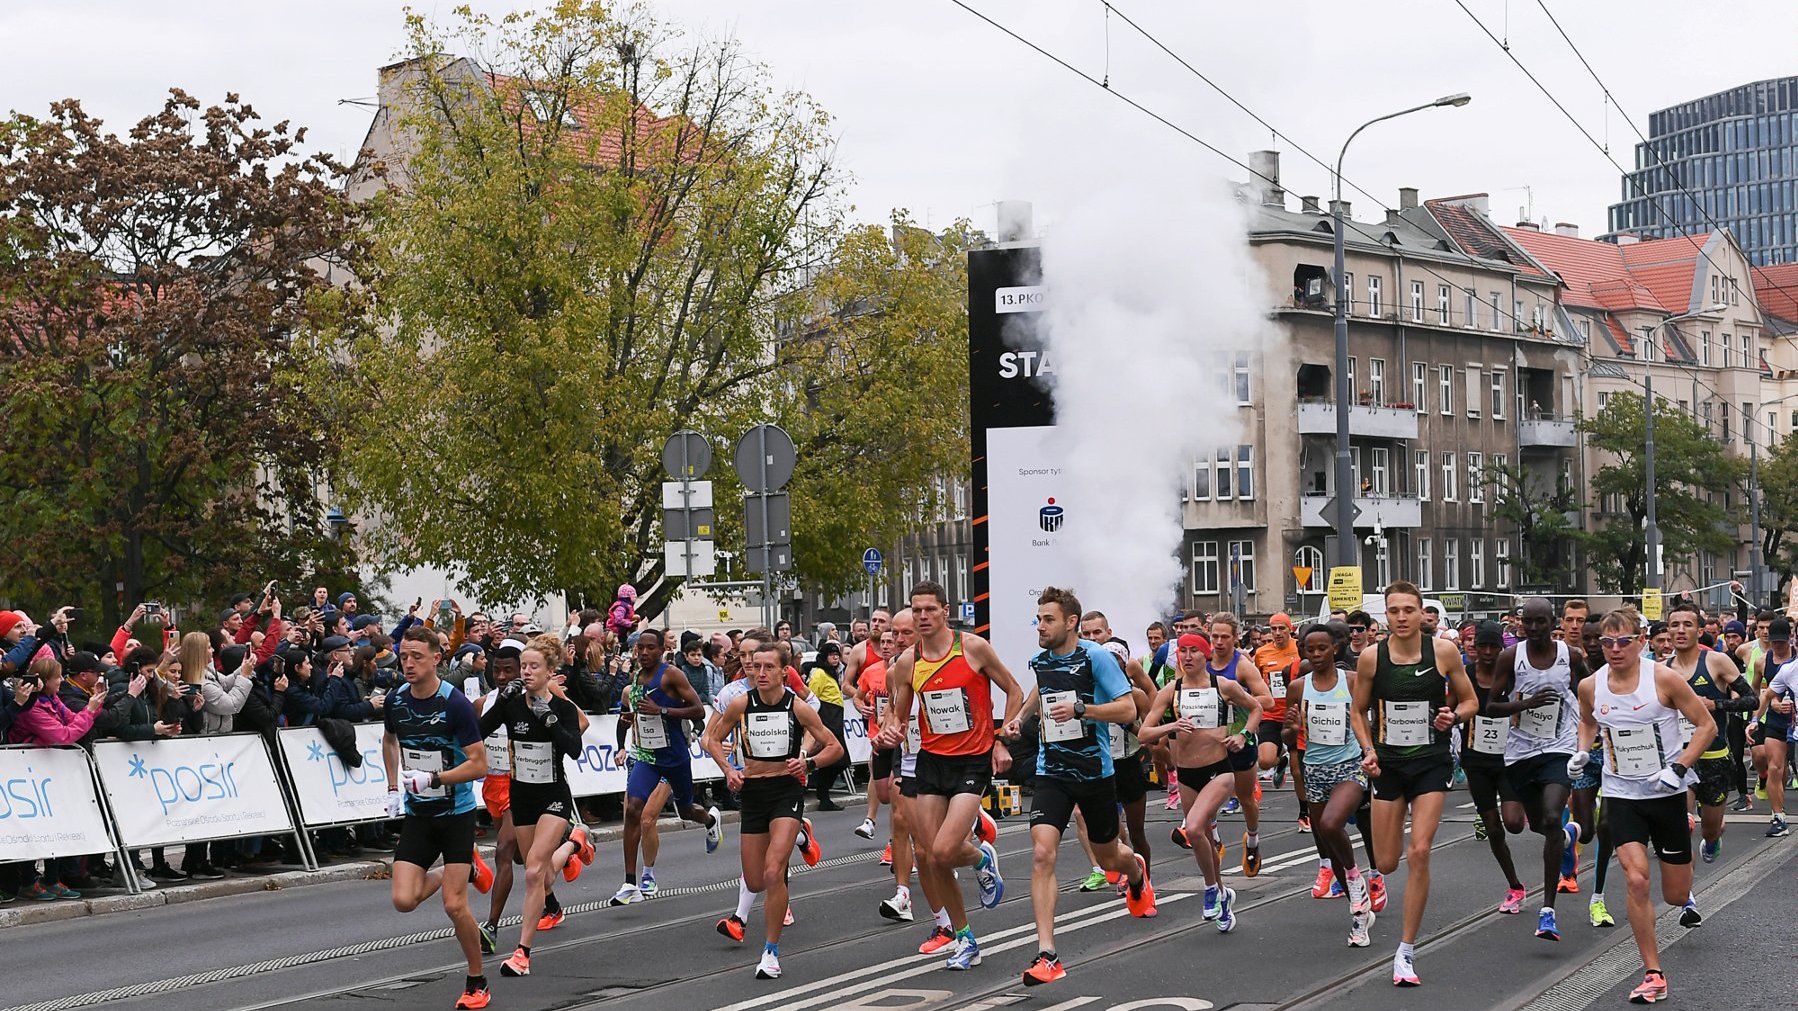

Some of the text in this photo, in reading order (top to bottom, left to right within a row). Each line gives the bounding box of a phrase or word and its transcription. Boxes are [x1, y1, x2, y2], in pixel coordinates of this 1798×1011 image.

[1018, 468, 1049, 477] Sponsor
[1032, 538, 1050, 547] Bank
[965, 604, 975, 616] P
[930, 704, 961, 715] Nowak
[1311, 715, 1341, 726] Gichia
[1525, 709, 1553, 722] Maiyo
[1387, 717, 1427, 725] Karbowiak
[642, 725, 655, 735] Esa
[749, 728, 788, 737] Nadolska
[1484, 729, 1498, 739] 23
[515, 755, 552, 766] Verbruggen
[150, 753, 239, 816] posir
